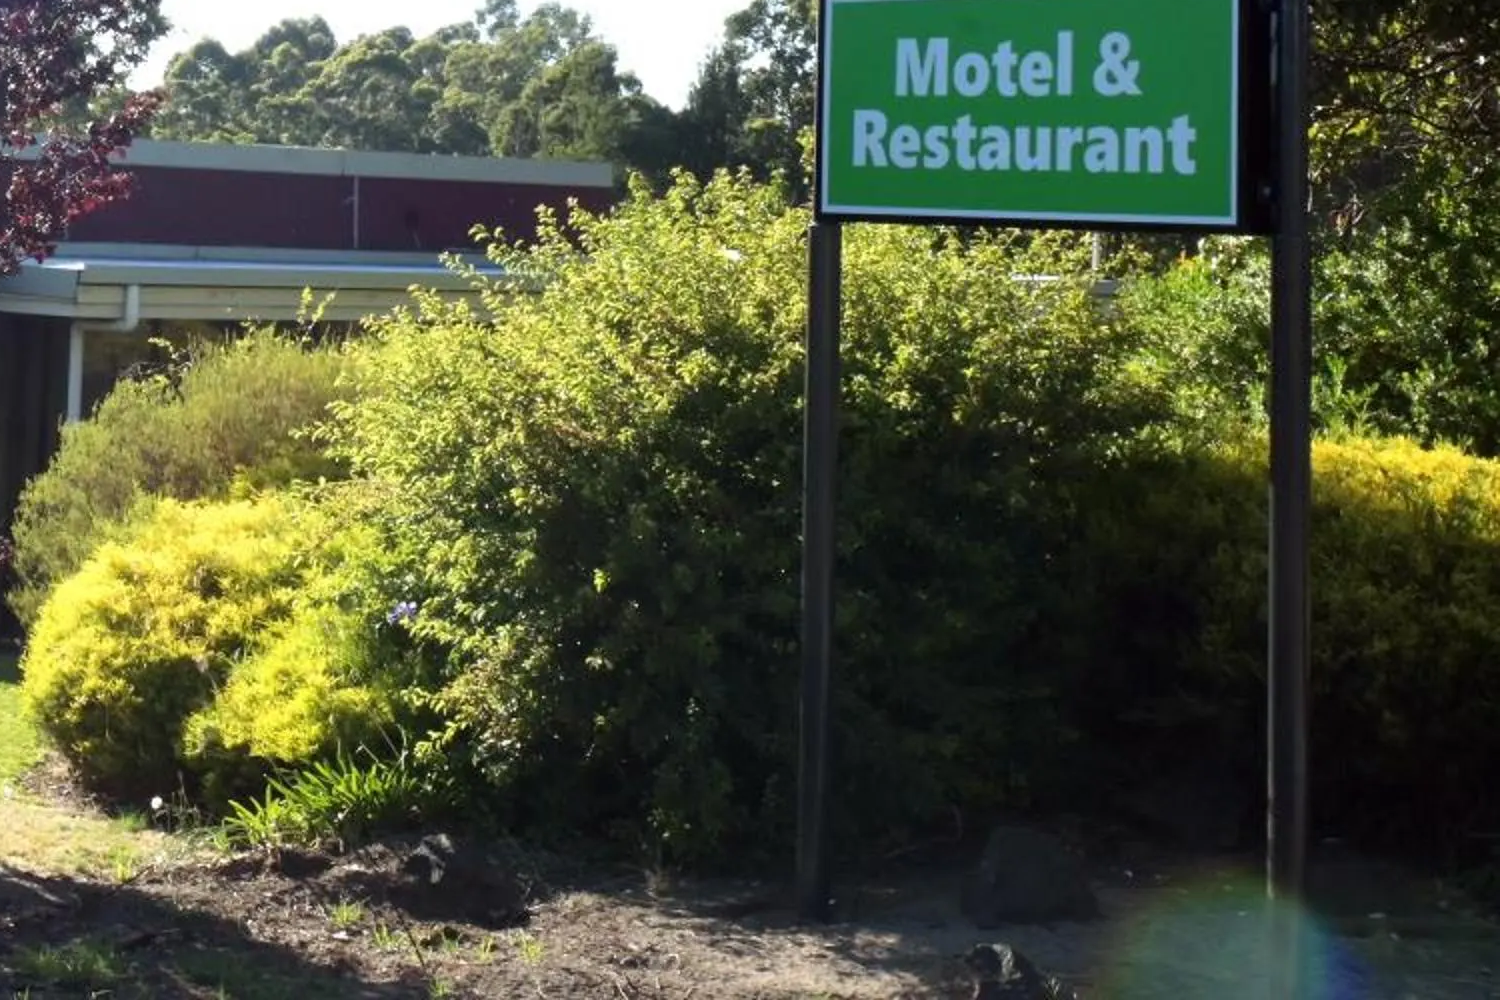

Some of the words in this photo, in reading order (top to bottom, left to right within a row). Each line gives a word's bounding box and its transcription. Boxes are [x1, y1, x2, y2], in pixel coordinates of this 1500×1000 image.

[894, 29, 1075, 98] Motel
[1092, 30, 1143, 97] &
[852, 108, 1197, 175] Restaurant
